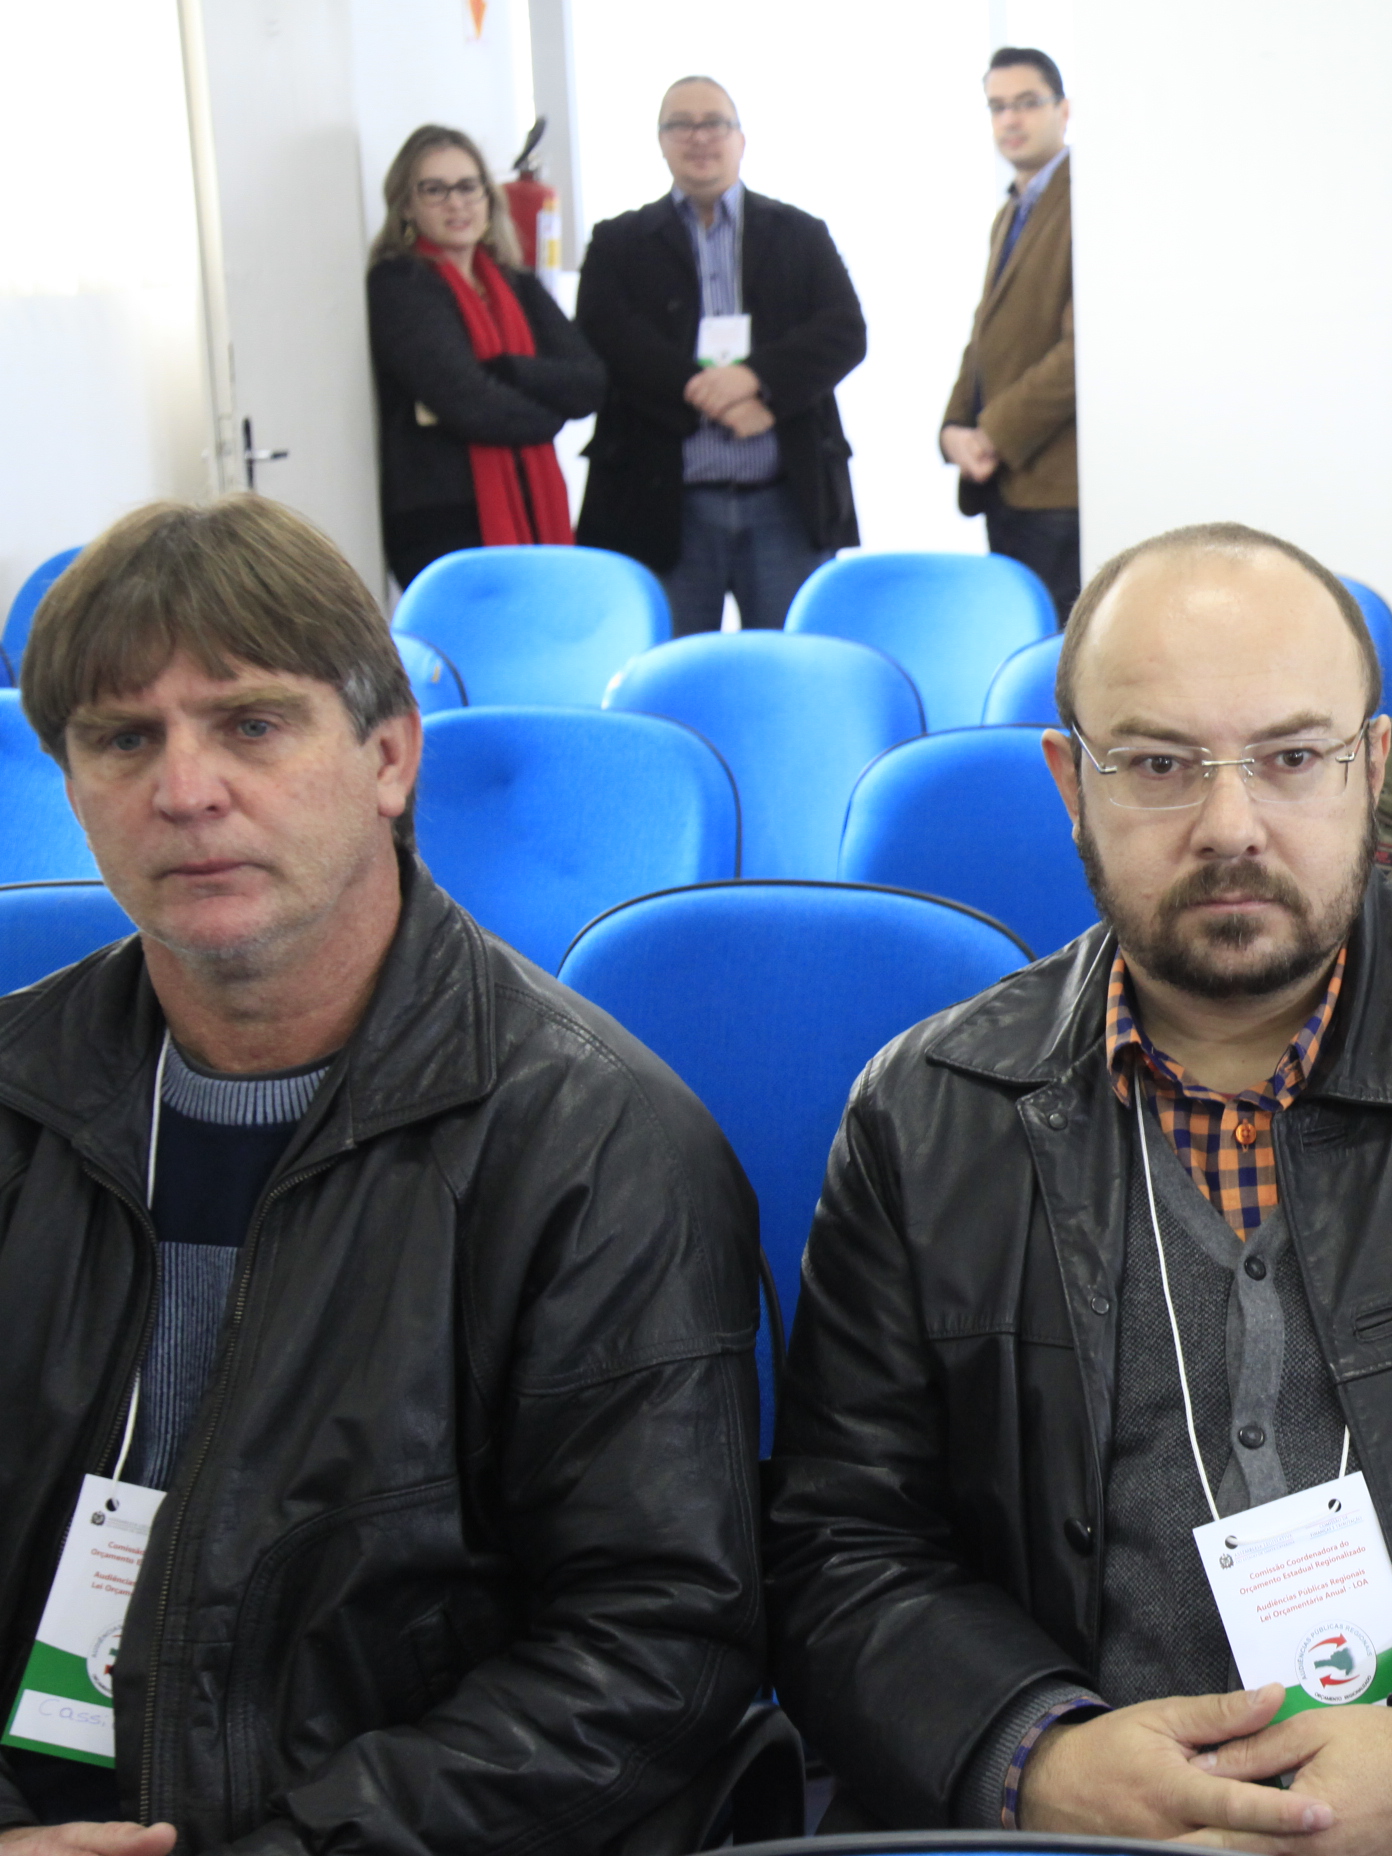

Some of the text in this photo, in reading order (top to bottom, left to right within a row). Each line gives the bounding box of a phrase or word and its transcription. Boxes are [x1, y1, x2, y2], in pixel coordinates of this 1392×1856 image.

[1239, 1546, 1366, 1595] Orçamento Estadual Regionalizado
[1249, 1540, 1350, 1580] Comissão Coordenadora do
[1256, 1568, 1365, 1612] Audiências Públicas Regionais
[1260, 1613, 1272, 1623] Lei
[1273, 1595, 1324, 1616] Orçamentária
[1325, 1586, 1347, 1599] Anual
[1352, 1578, 1369, 1589] LOA
